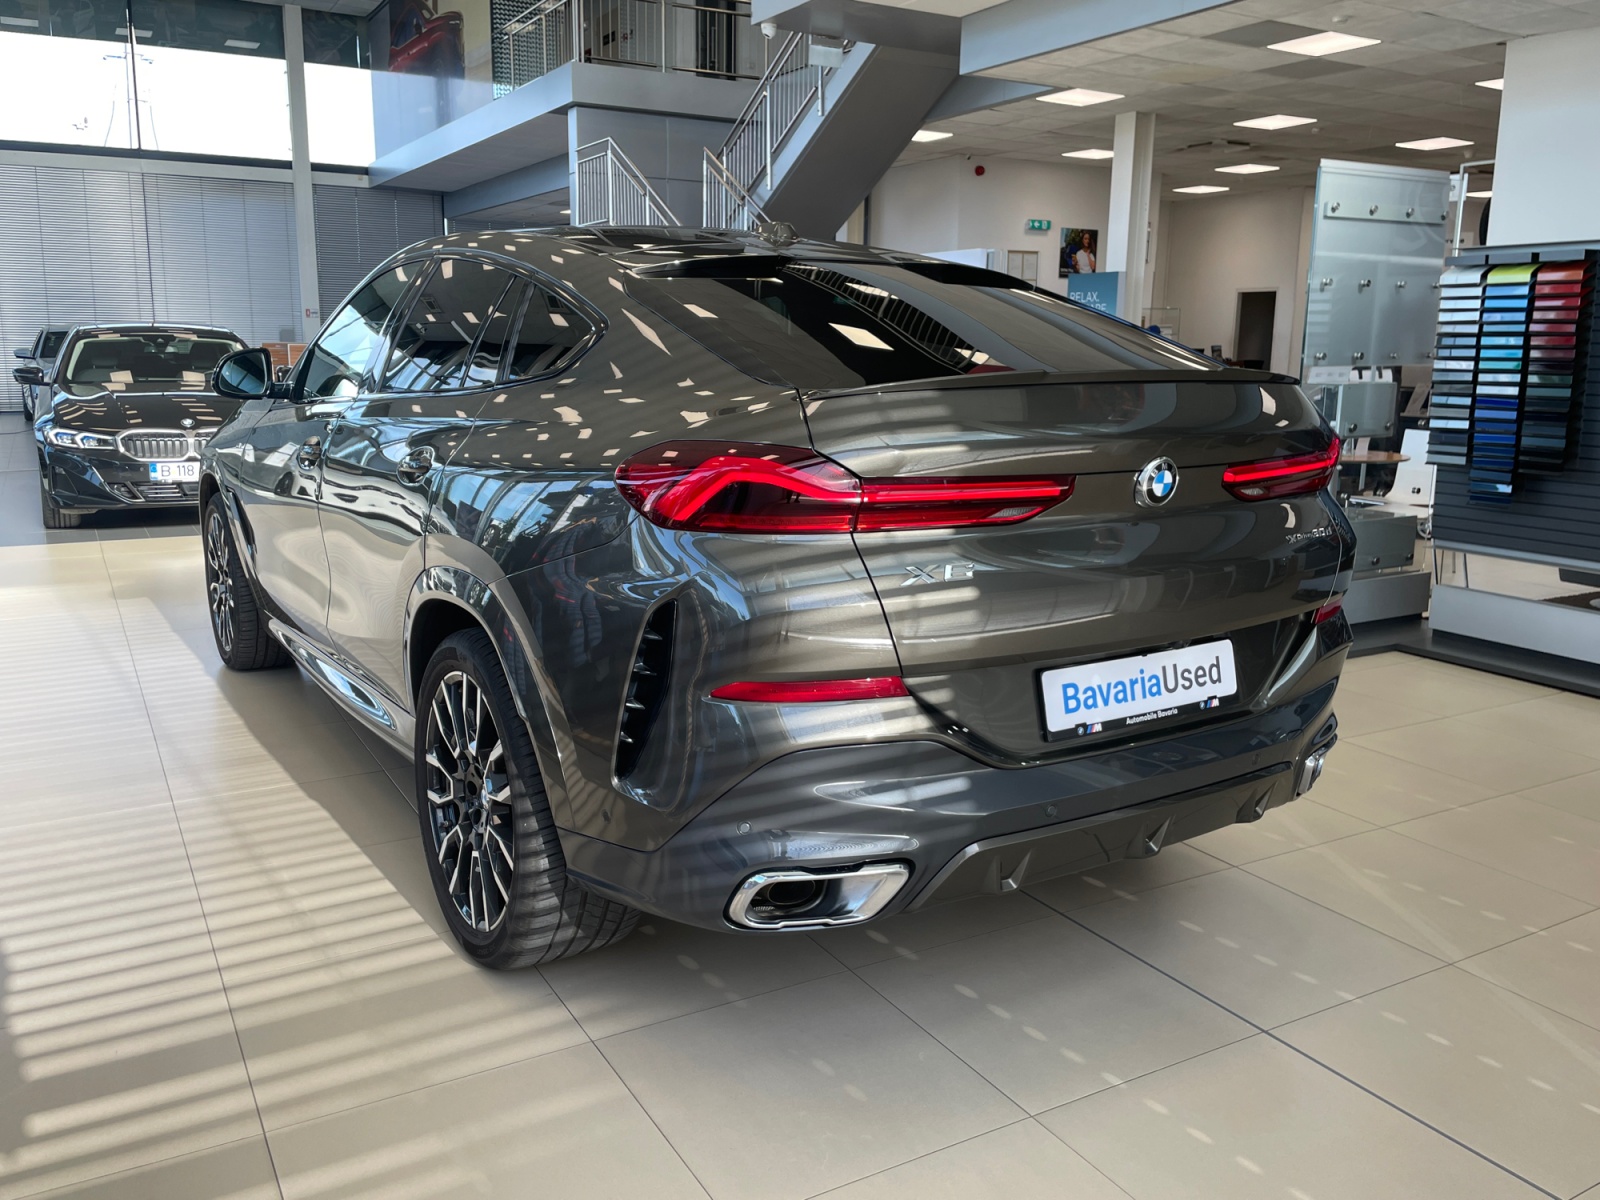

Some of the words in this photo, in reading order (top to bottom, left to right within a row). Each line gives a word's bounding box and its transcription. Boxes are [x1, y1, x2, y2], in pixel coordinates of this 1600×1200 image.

[161, 465, 171, 477] B
[177, 464, 195, 477] 118
[1062, 655, 1222, 715] BavariaUsed
[1126, 711, 1157, 725] Automobile
[1157, 707, 1178, 719] Bavaria
